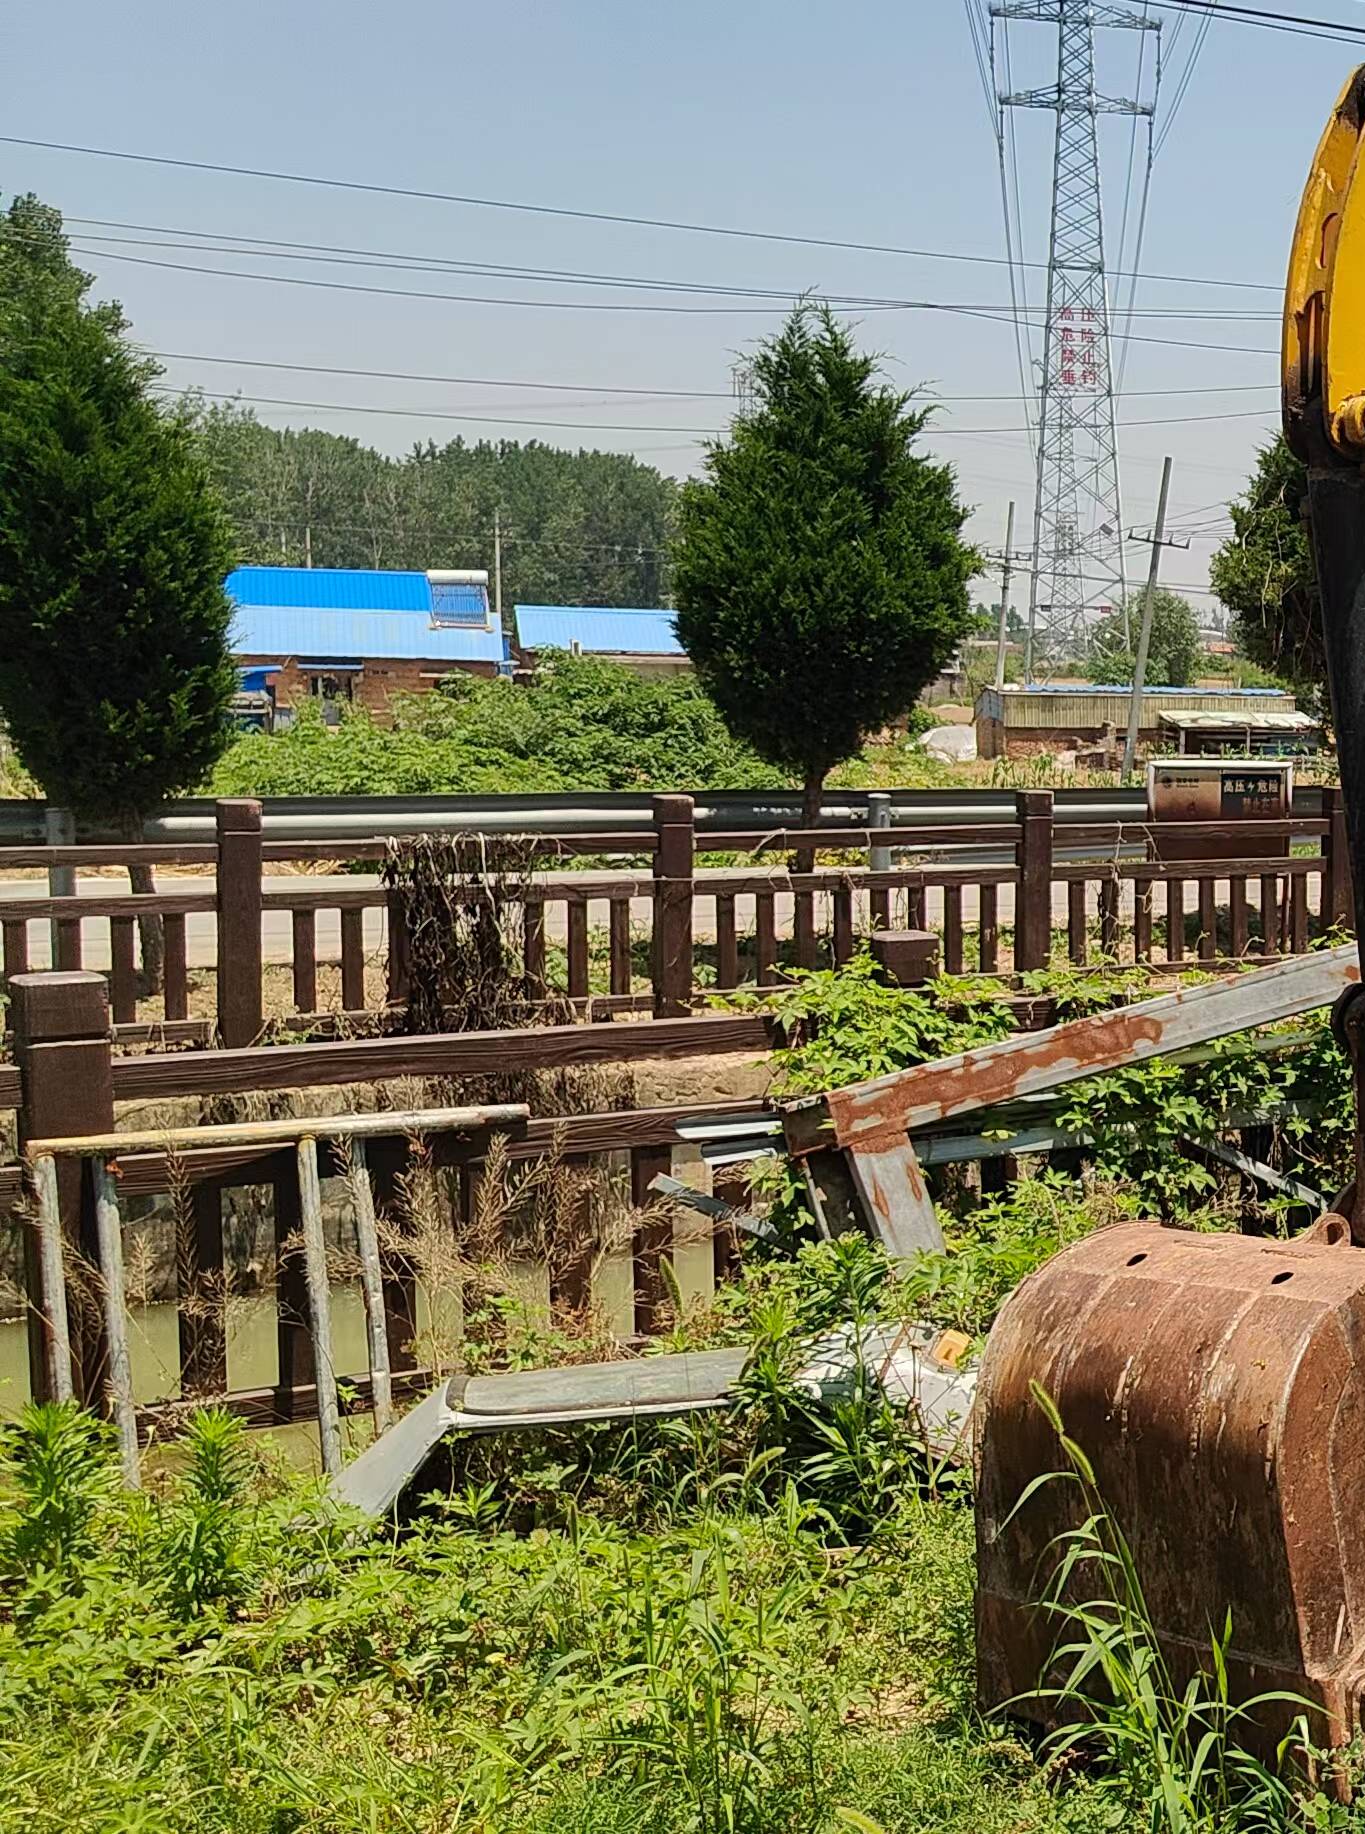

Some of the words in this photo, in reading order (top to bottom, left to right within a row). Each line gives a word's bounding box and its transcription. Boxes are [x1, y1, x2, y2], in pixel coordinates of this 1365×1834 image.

[1061, 327, 1096, 342] 危险
[1061, 370, 1097, 385] 垂钓
[1224, 779, 1245, 793] 高压
[1257, 779, 1278, 793] 危险
